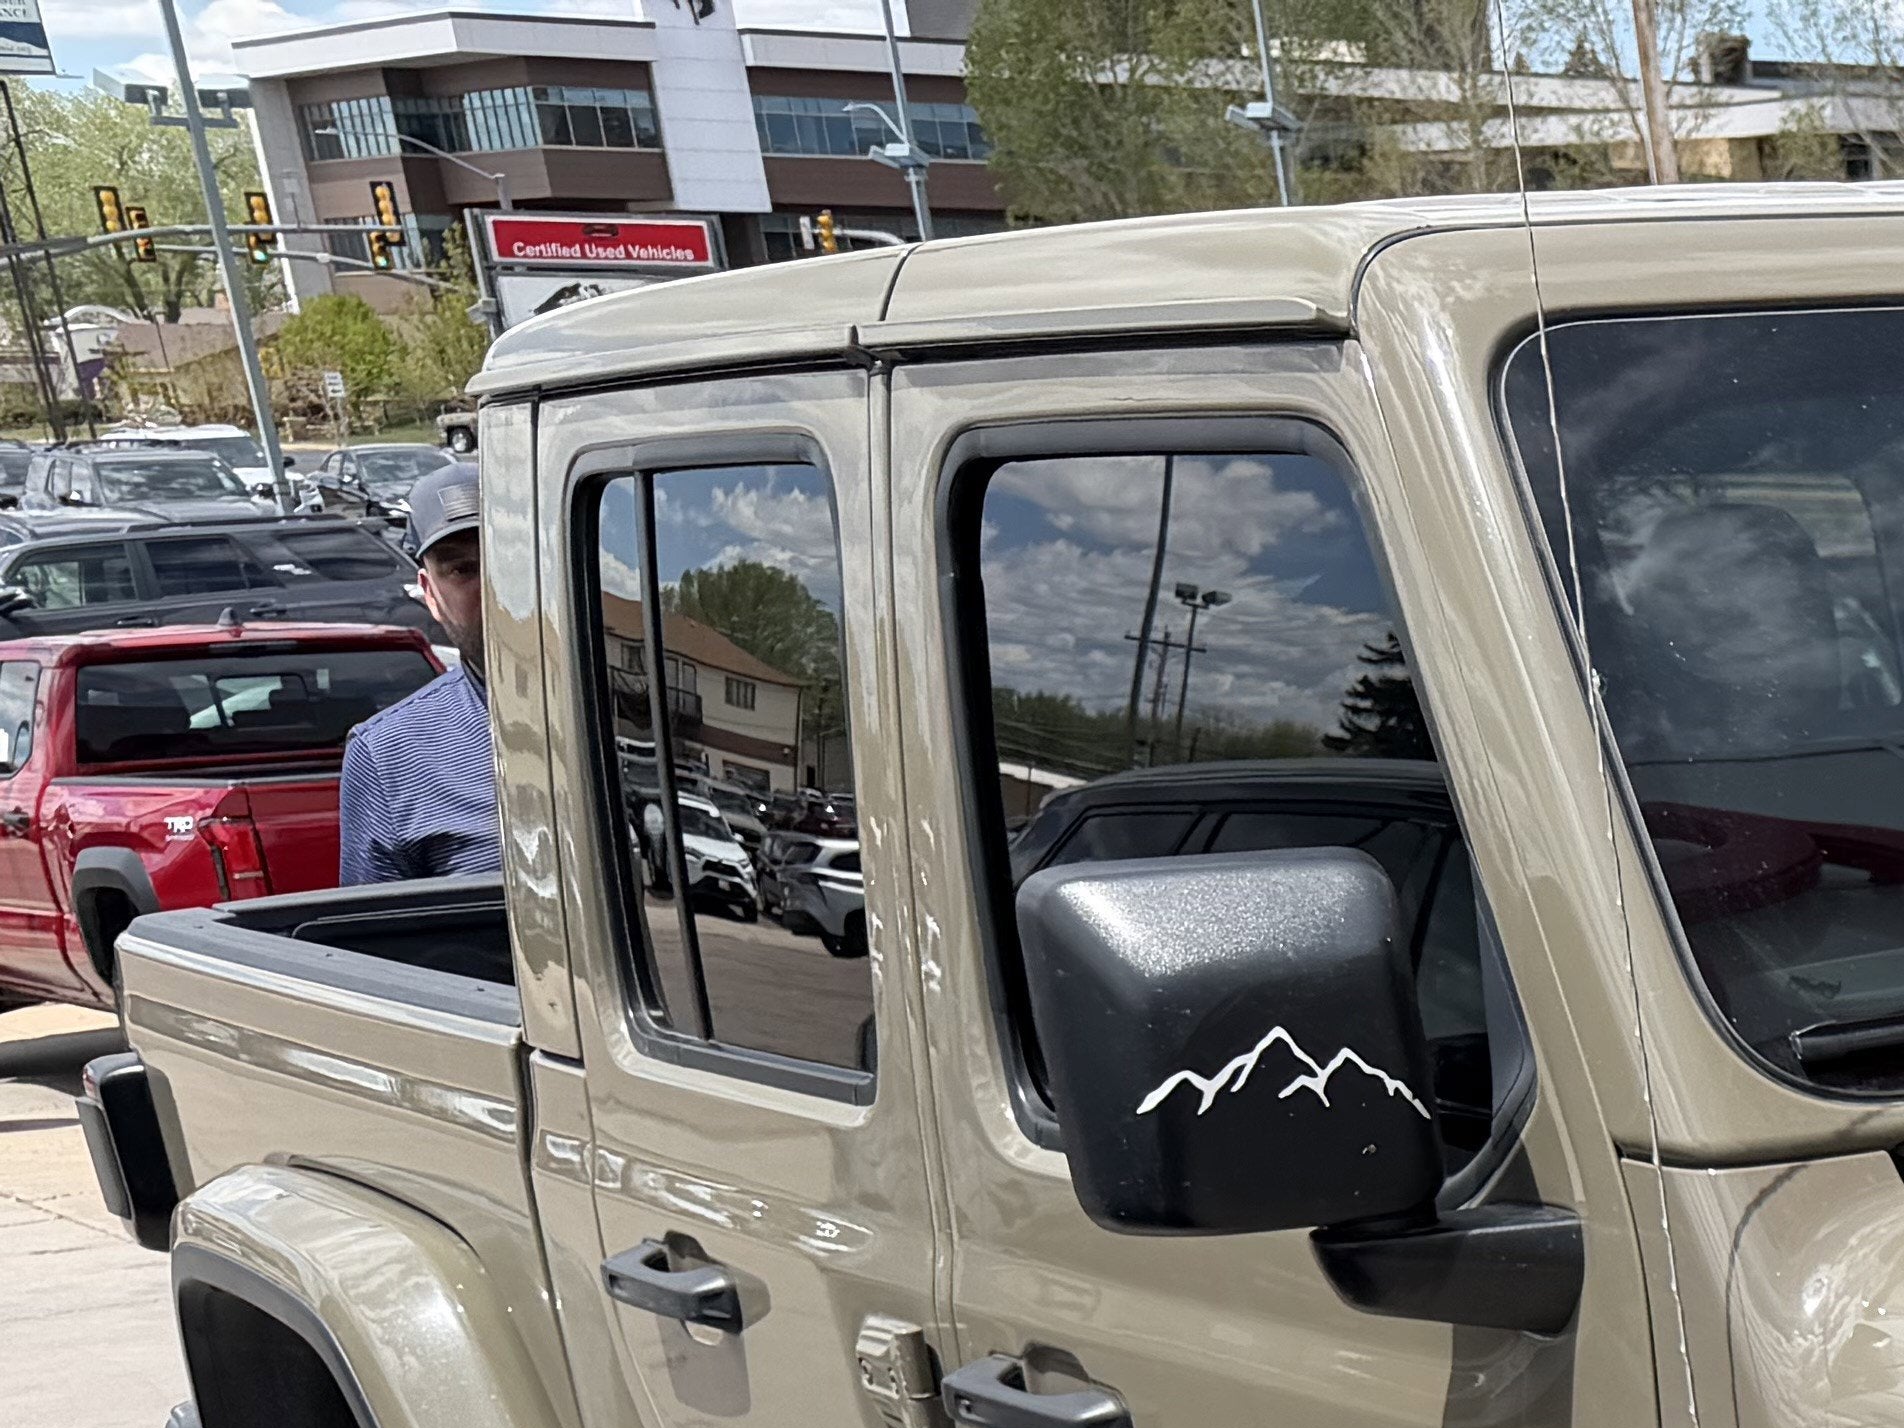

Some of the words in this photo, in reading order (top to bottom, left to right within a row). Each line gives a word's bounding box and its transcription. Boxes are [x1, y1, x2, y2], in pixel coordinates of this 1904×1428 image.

[512, 241, 581, 258] Certified
[584, 243, 626, 259] Used
[627, 244, 695, 261] Vehicles
